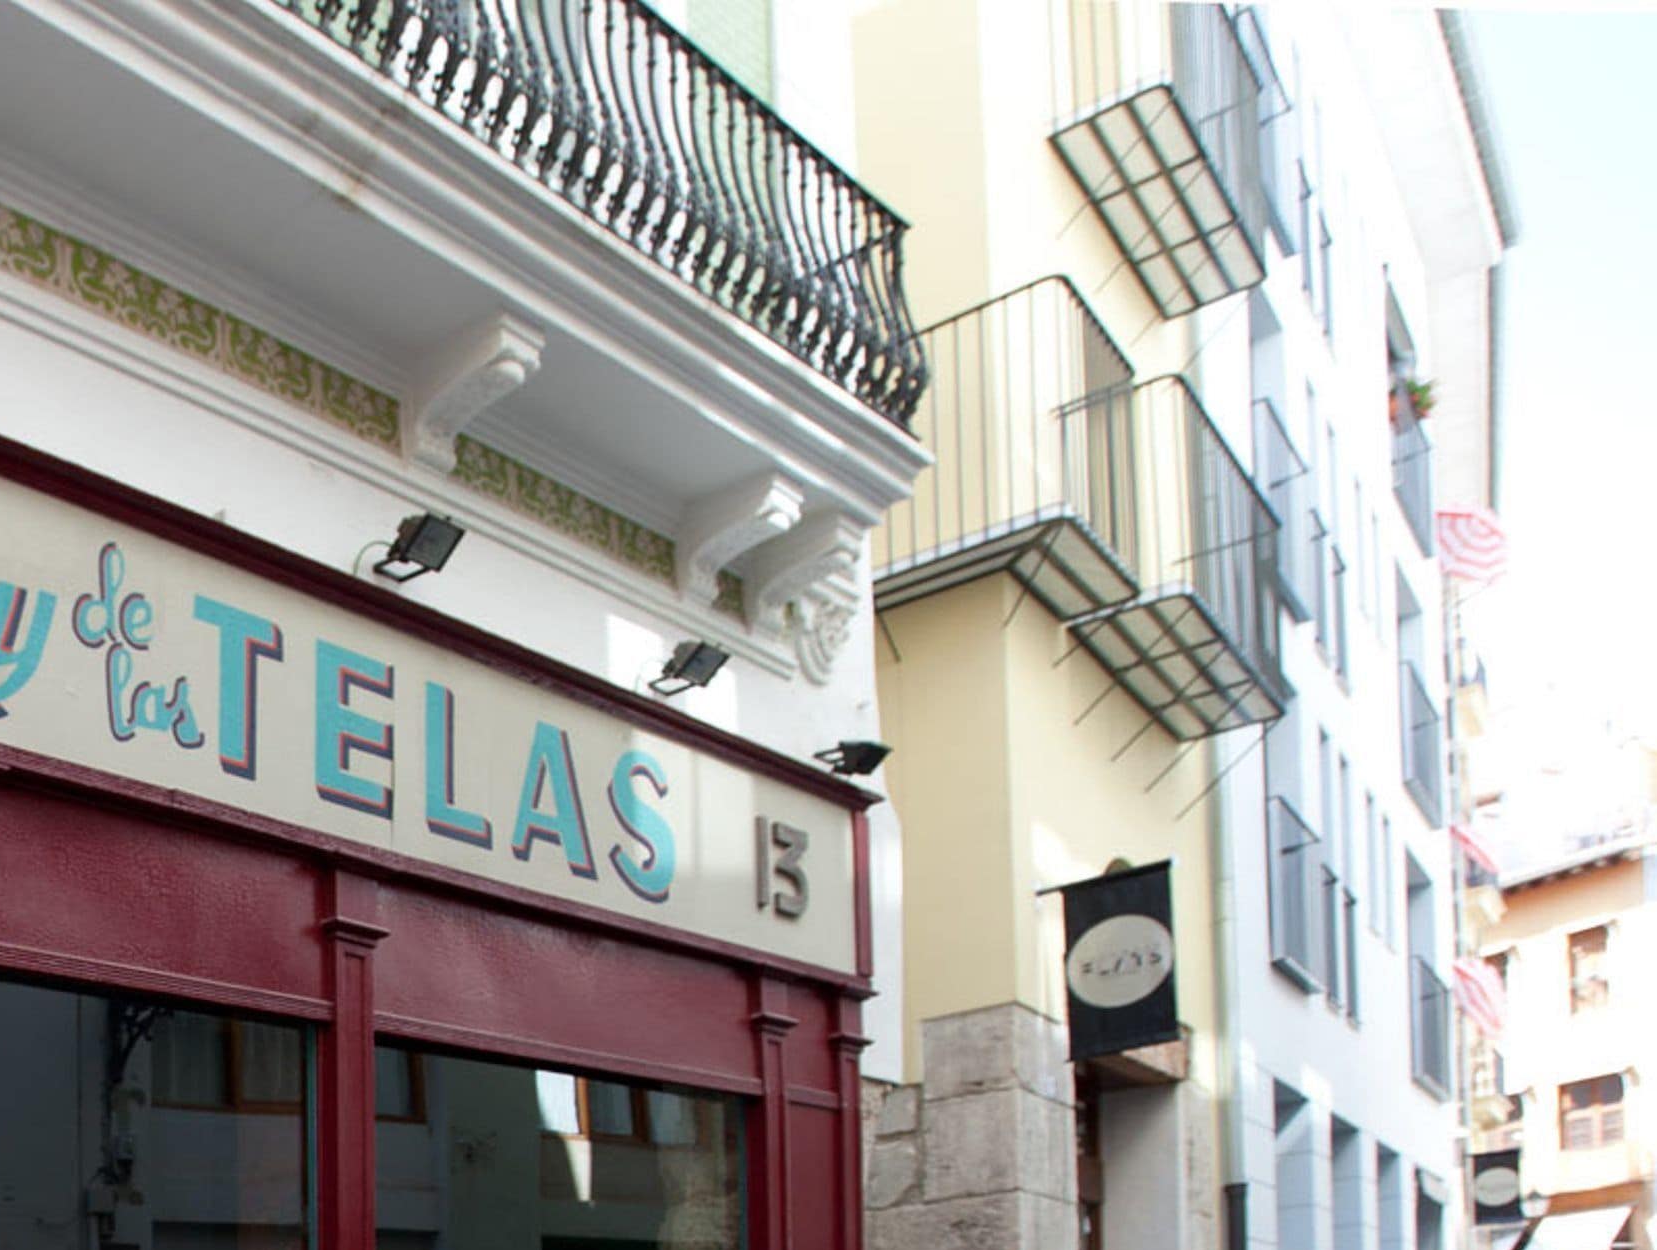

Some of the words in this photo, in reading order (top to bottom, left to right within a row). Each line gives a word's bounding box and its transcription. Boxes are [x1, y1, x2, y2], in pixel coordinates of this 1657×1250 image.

[72, 542, 154, 650] de
[106, 640, 205, 749] las
[193, 594, 677, 904] TELAS
[756, 814, 810, 922] 13
